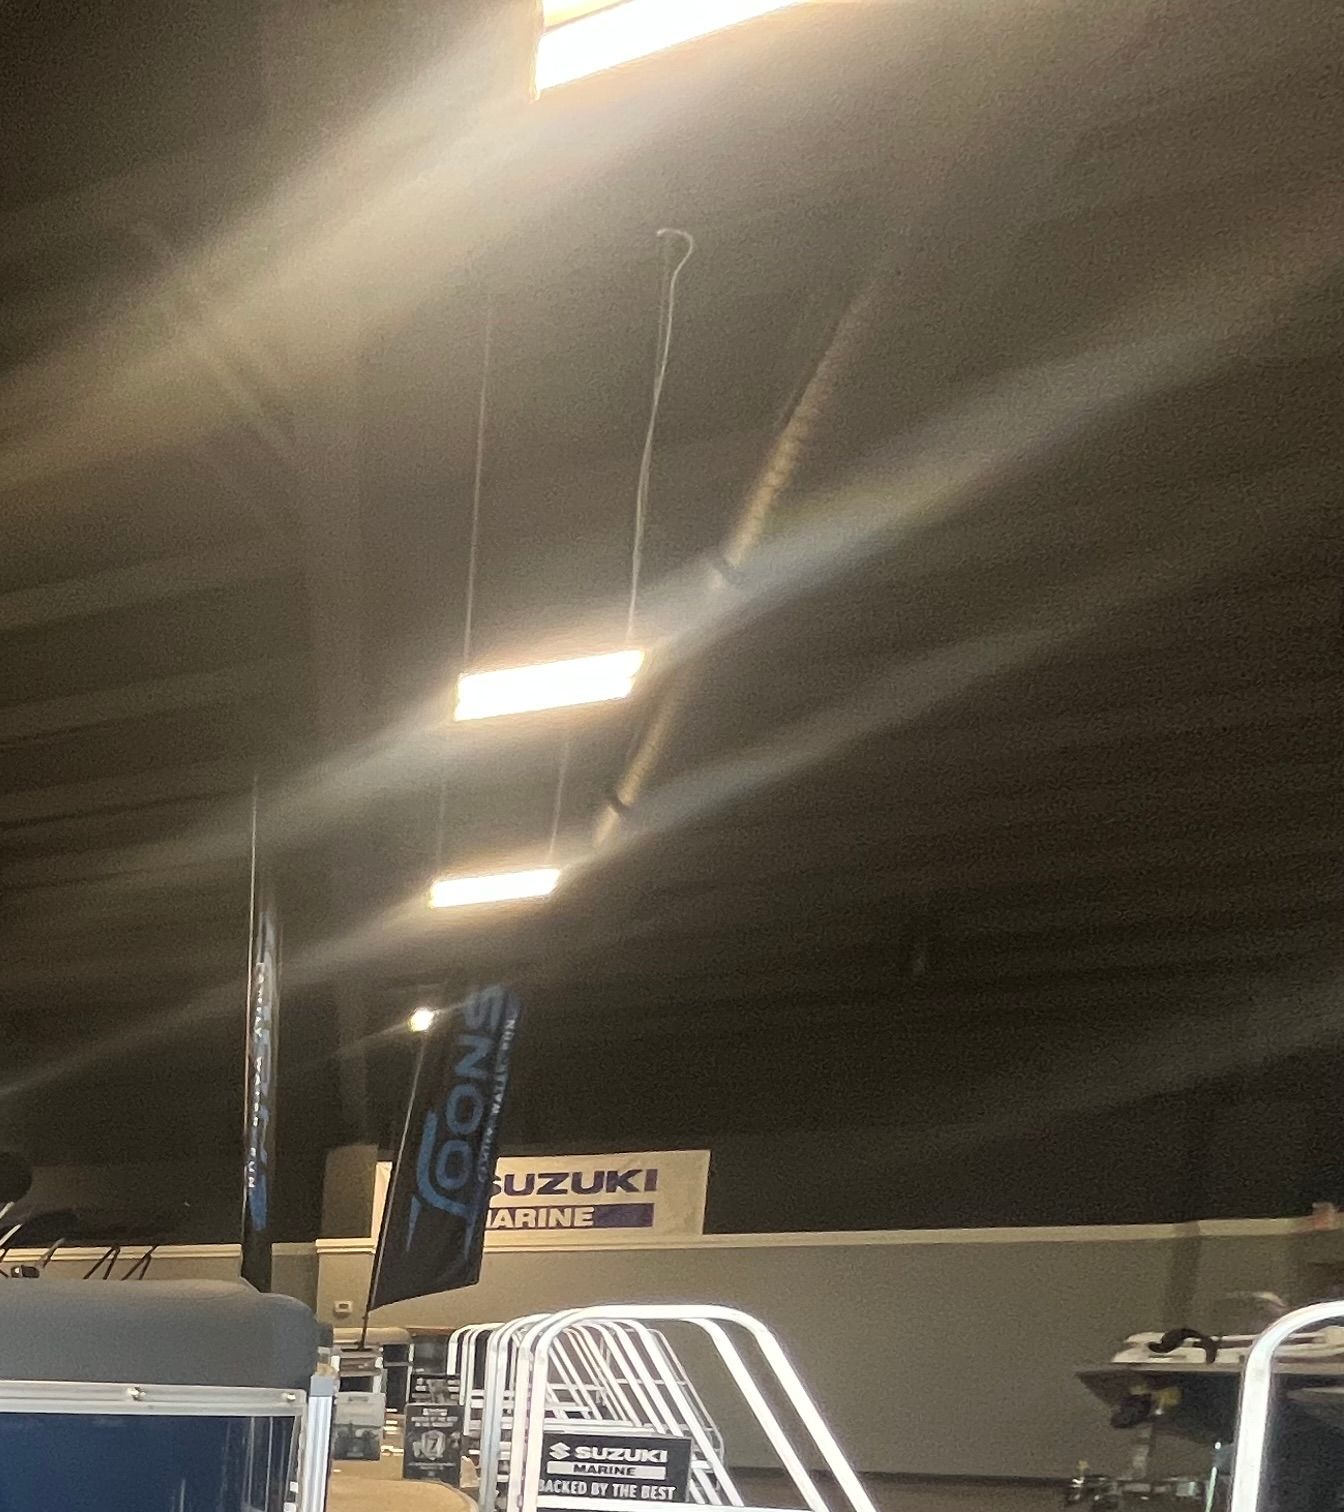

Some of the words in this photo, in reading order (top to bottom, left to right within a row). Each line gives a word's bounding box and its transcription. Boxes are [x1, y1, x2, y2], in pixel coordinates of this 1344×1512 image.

[486, 1206, 594, 1229] ARINE
[574, 1446, 668, 1463] SUZUKI
[573, 1463, 637, 1476] MARINE
[538, 1479, 588, 1495] BACKED
[590, 1481, 609, 1497] BY
[612, 1483, 637, 1498] THE
[640, 1485, 677, 1500] BEST
